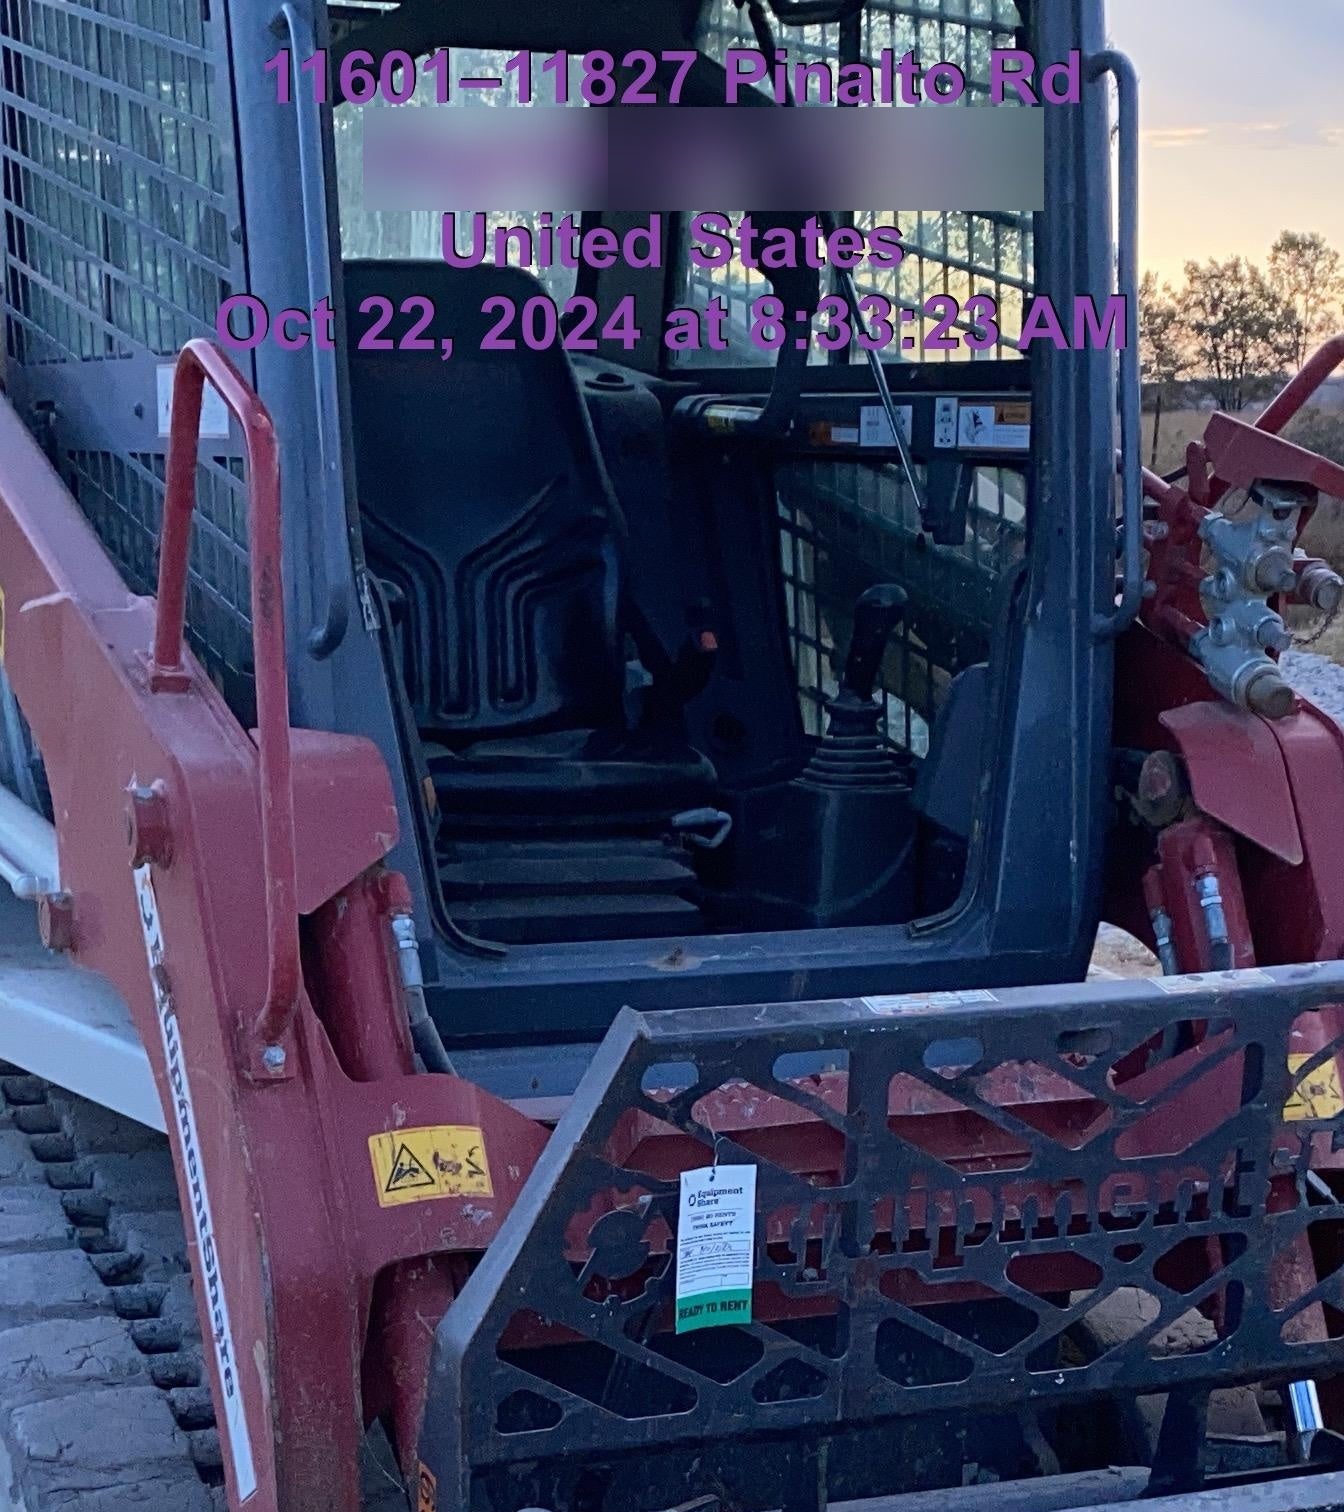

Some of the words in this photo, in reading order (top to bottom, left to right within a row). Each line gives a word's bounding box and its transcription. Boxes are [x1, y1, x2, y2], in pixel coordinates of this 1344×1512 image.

[678, 1304, 705, 1321] READY
[706, 1302, 718, 1313] TO
[720, 1300, 749, 1312] RENT
